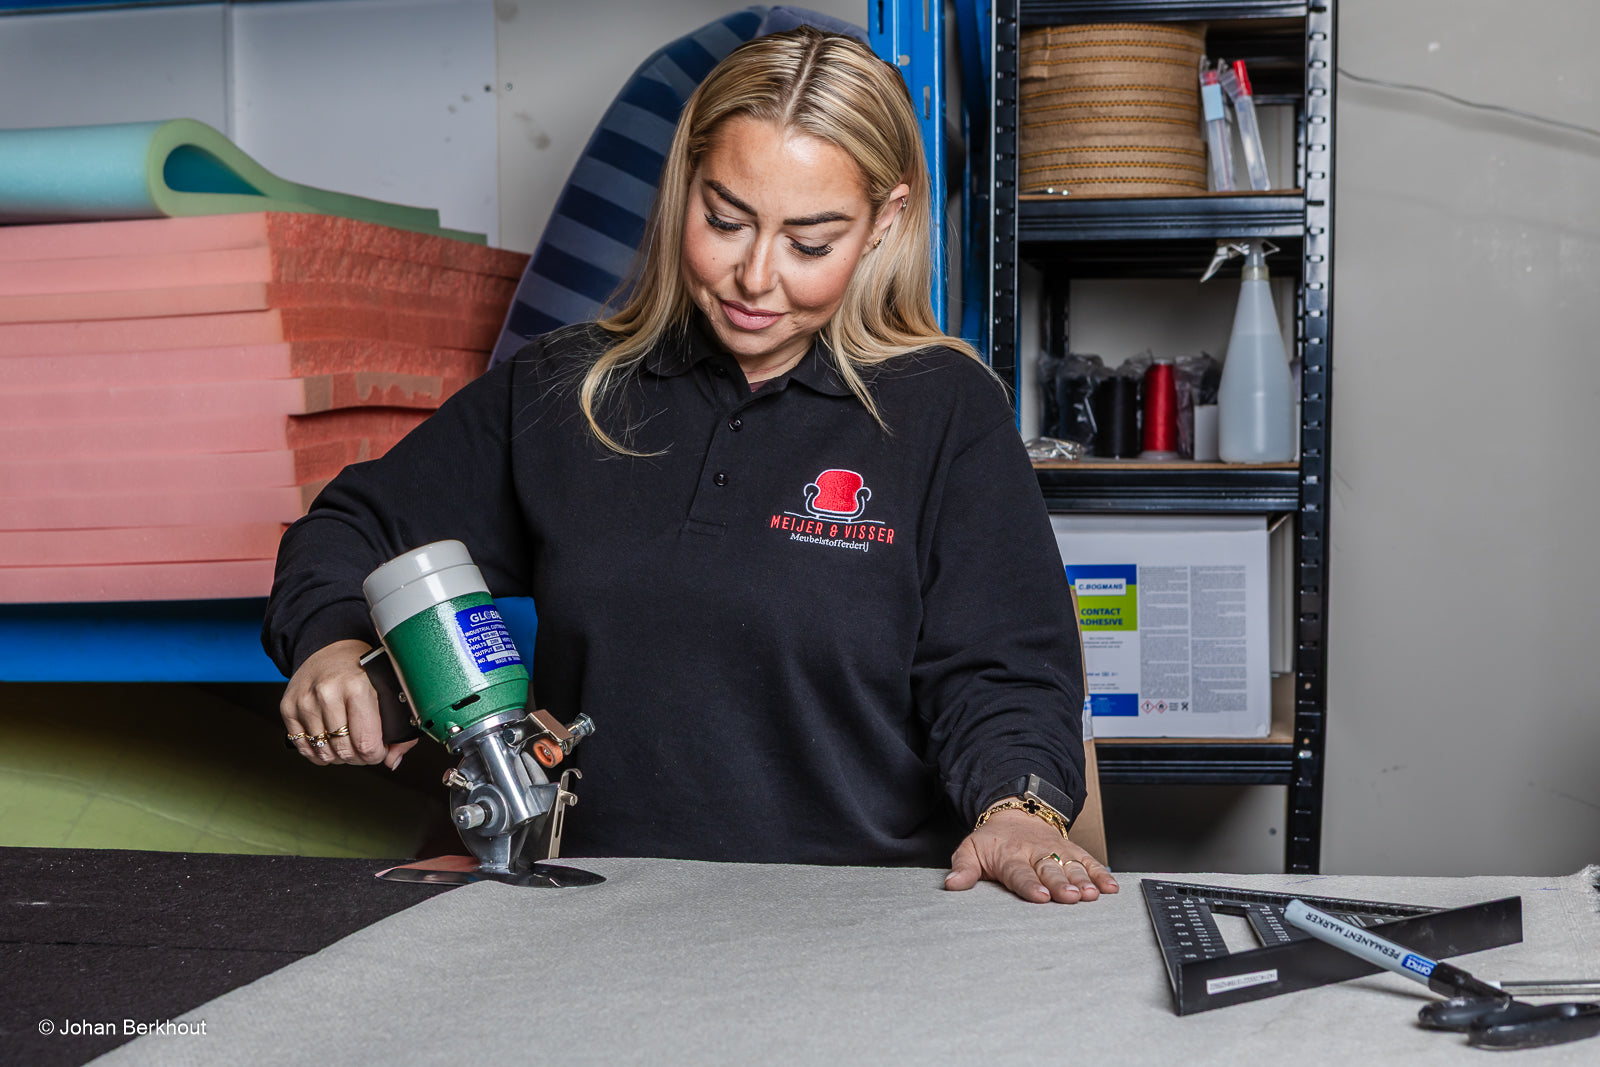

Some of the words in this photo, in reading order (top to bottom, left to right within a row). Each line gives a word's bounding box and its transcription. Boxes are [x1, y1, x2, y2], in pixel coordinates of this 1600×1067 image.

[770, 514, 824, 535] MEIJER
[829, 524, 839, 538] &
[844, 524, 895, 545] VISSER
[470, 610, 502, 622] GLOBA
[1080, 607, 1121, 616] CONTACT
[1080, 617, 1123, 626] ADHESIVE
[465, 625, 491, 637] INDUSTRIAL
[471, 642, 487, 650] VOLTS
[475, 648, 493, 657] OUTPUT
[1304, 911, 1343, 935] MARKER
[1343, 928, 1401, 960] PERMANENT
